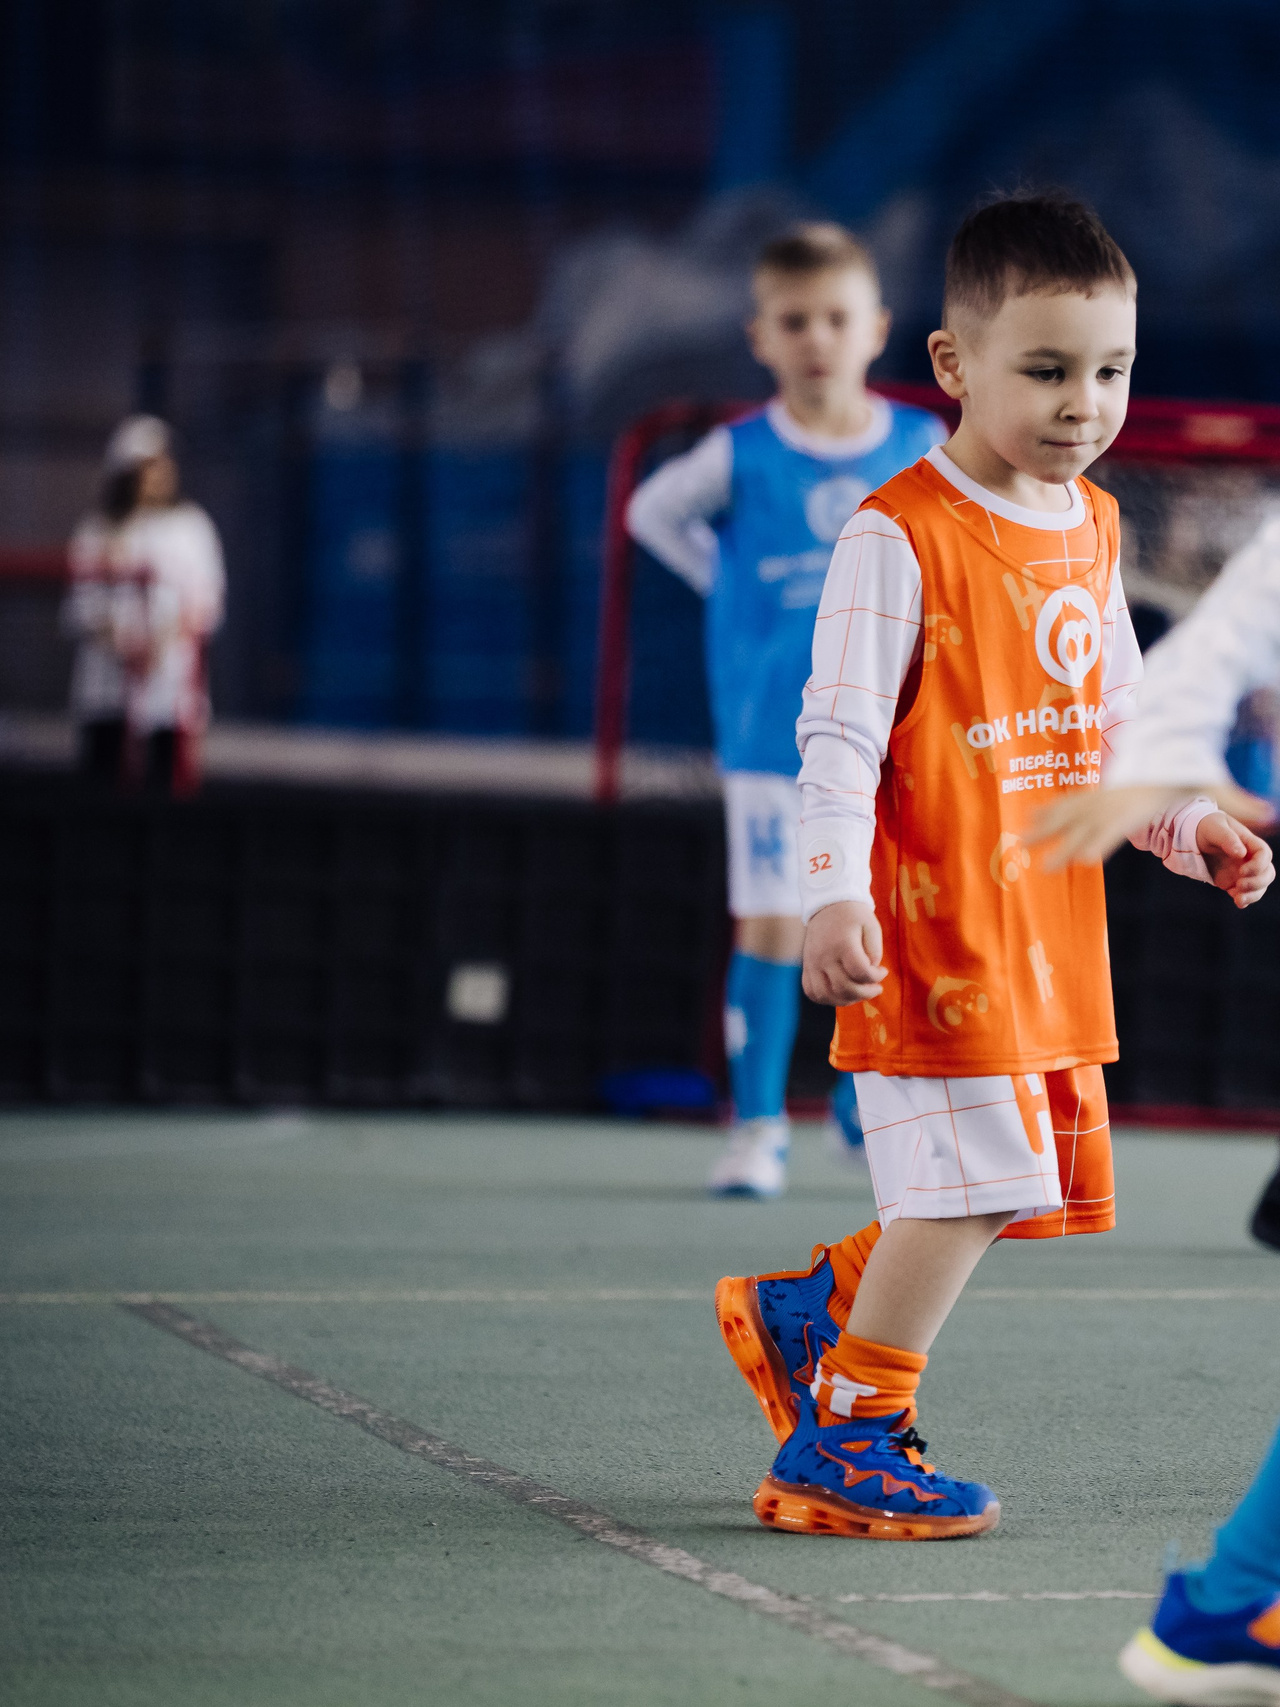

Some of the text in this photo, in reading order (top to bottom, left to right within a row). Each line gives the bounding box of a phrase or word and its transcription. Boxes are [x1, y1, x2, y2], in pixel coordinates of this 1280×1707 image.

[966, 716, 1012, 749] ФК
[1009, 750, 1070, 774] ВПЕРЁД
[1002, 773, 1054, 795] ВМЕСТЕ
[809, 853, 832, 874] 32
